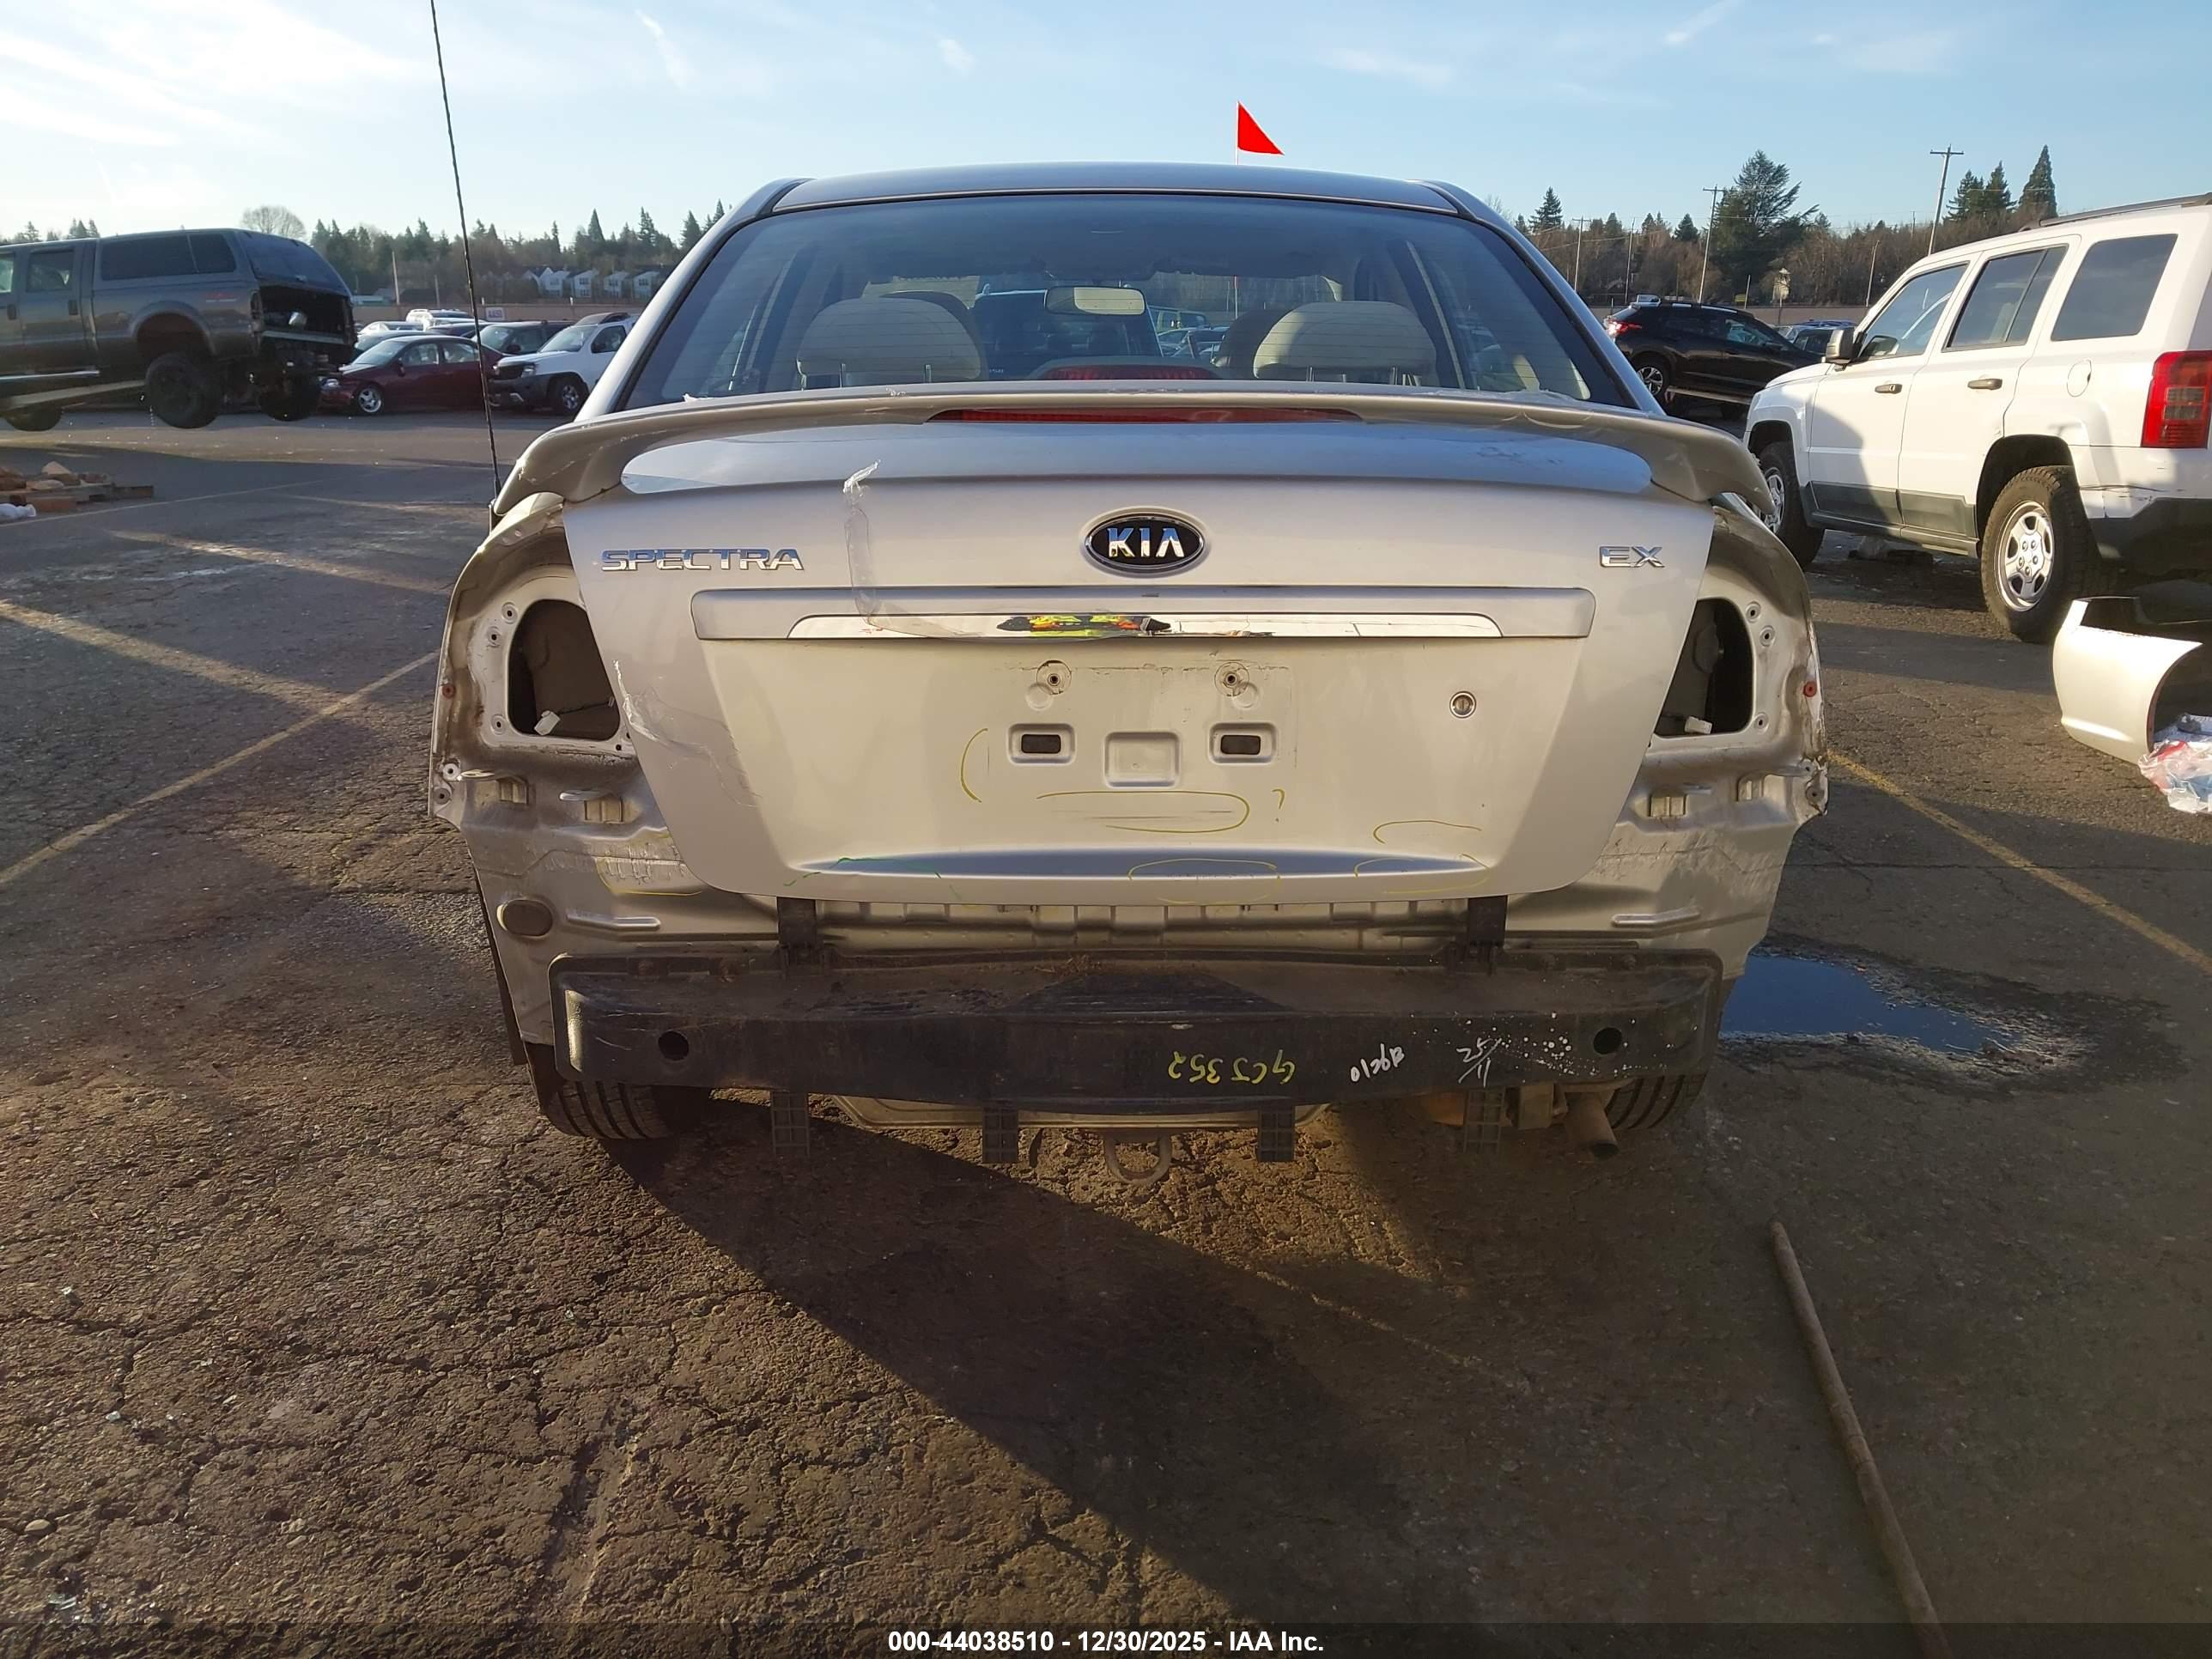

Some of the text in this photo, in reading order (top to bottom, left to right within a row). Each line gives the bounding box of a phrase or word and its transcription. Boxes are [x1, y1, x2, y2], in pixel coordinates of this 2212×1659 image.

[1108, 527, 1184, 557] KIA
[602, 549, 805, 571] SPECTRA
[1599, 545, 1666, 568] EX
